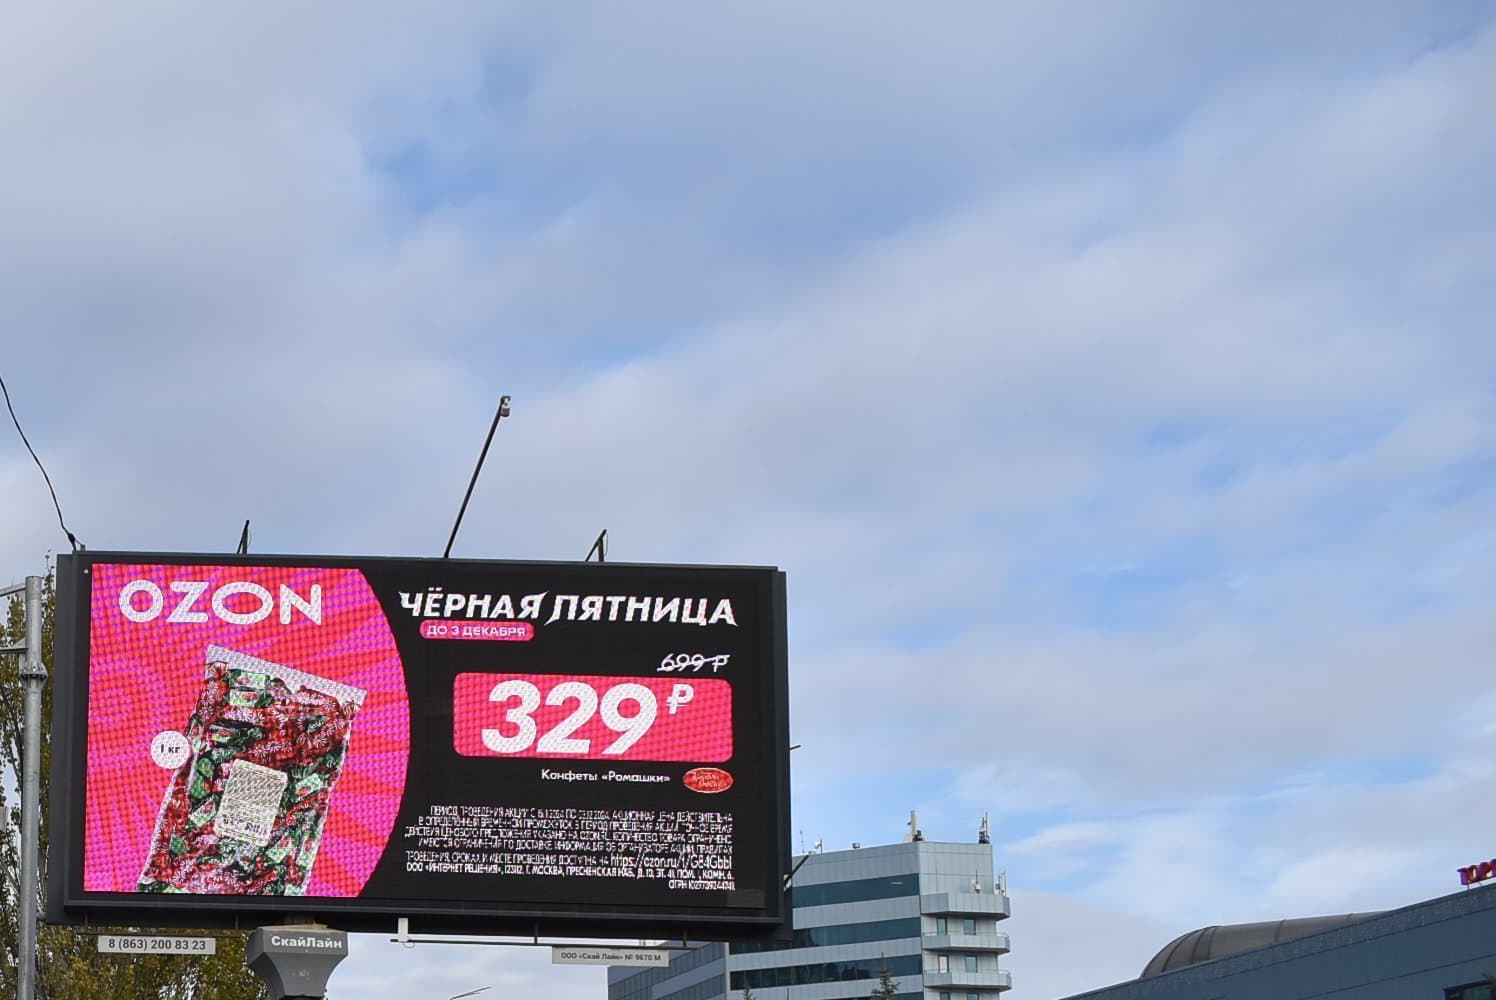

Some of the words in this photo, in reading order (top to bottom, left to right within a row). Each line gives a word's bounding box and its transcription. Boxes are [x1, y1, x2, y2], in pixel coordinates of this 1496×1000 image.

[119, 579, 322, 626] OZON
[399, 587, 549, 619] ЧЁРНАЯ
[544, 594, 737, 626] ПЯТНИЦА
[427, 625, 448, 637] ДО
[451, 626, 460, 637] 3
[463, 626, 526, 638] ДЕКАБРЯ
[481, 680, 657, 755] 329
[541, 769, 598, 783] Конфеты
[601, 770, 671, 783] «Ромашки»
[108, 938, 115, 949] 8
[118, 938, 148, 951] (863)
[151, 939, 171, 950] 200
[174, 940, 189, 950] 83
[191, 940, 206, 950] 23
[271, 935, 342, 949] СкайЛайн
